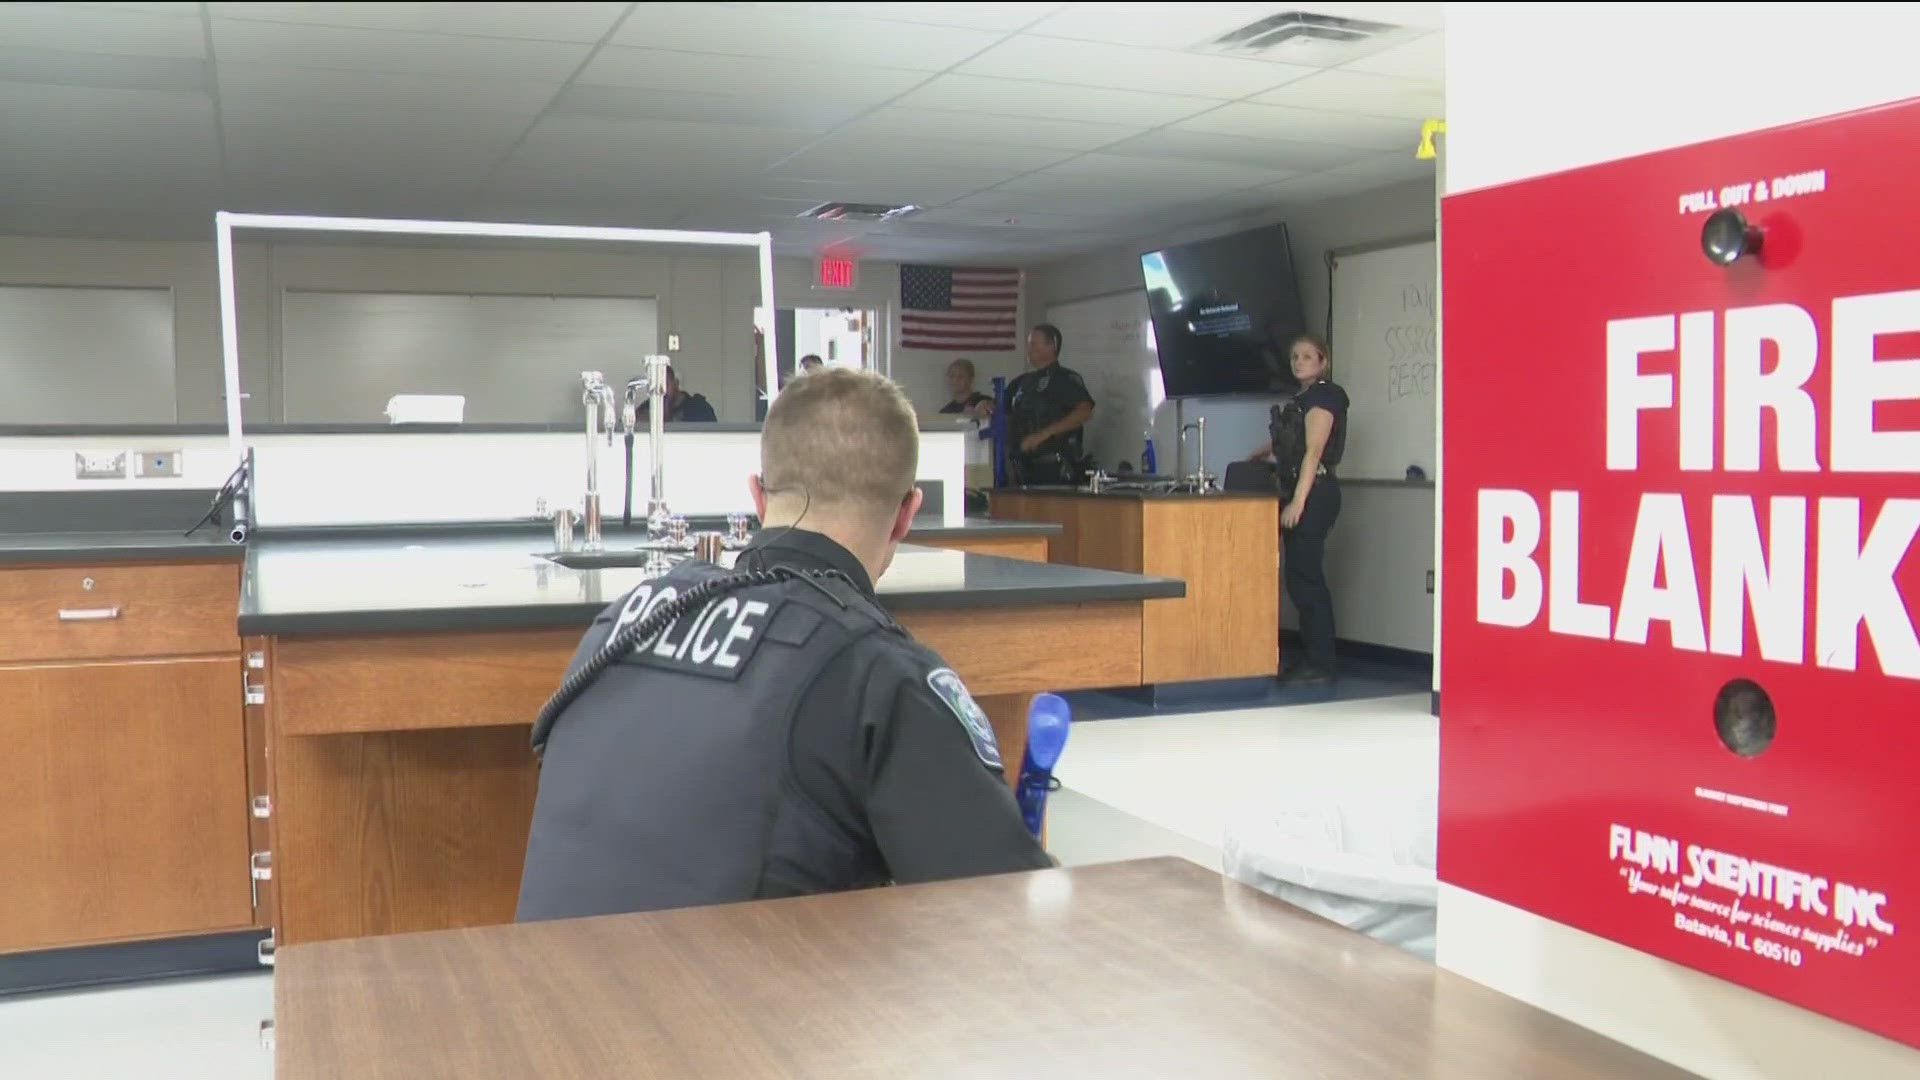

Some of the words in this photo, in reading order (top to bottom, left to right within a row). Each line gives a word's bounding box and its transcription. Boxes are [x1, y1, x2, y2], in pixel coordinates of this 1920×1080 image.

[1679, 190, 1717, 214] PULL
[1720, 183, 1751, 208] OUT
[1754, 180, 1769, 203] &
[1772, 169, 1826, 200] DOWN
[822, 260, 853, 288] EXIT
[1606, 289, 1920, 473] FIRE
[1609, 823, 1679, 874] FLINN
[1682, 844, 1828, 916] SCIENTIFIC
[1834, 882, 1894, 935] INC.
[1674, 912, 1732, 947] Batavia,
[1735, 931, 1750, 951] IL
[1753, 938, 1802, 966] 60510
[1730, 899, 1751, 925] for
[1752, 912, 1800, 938] science
